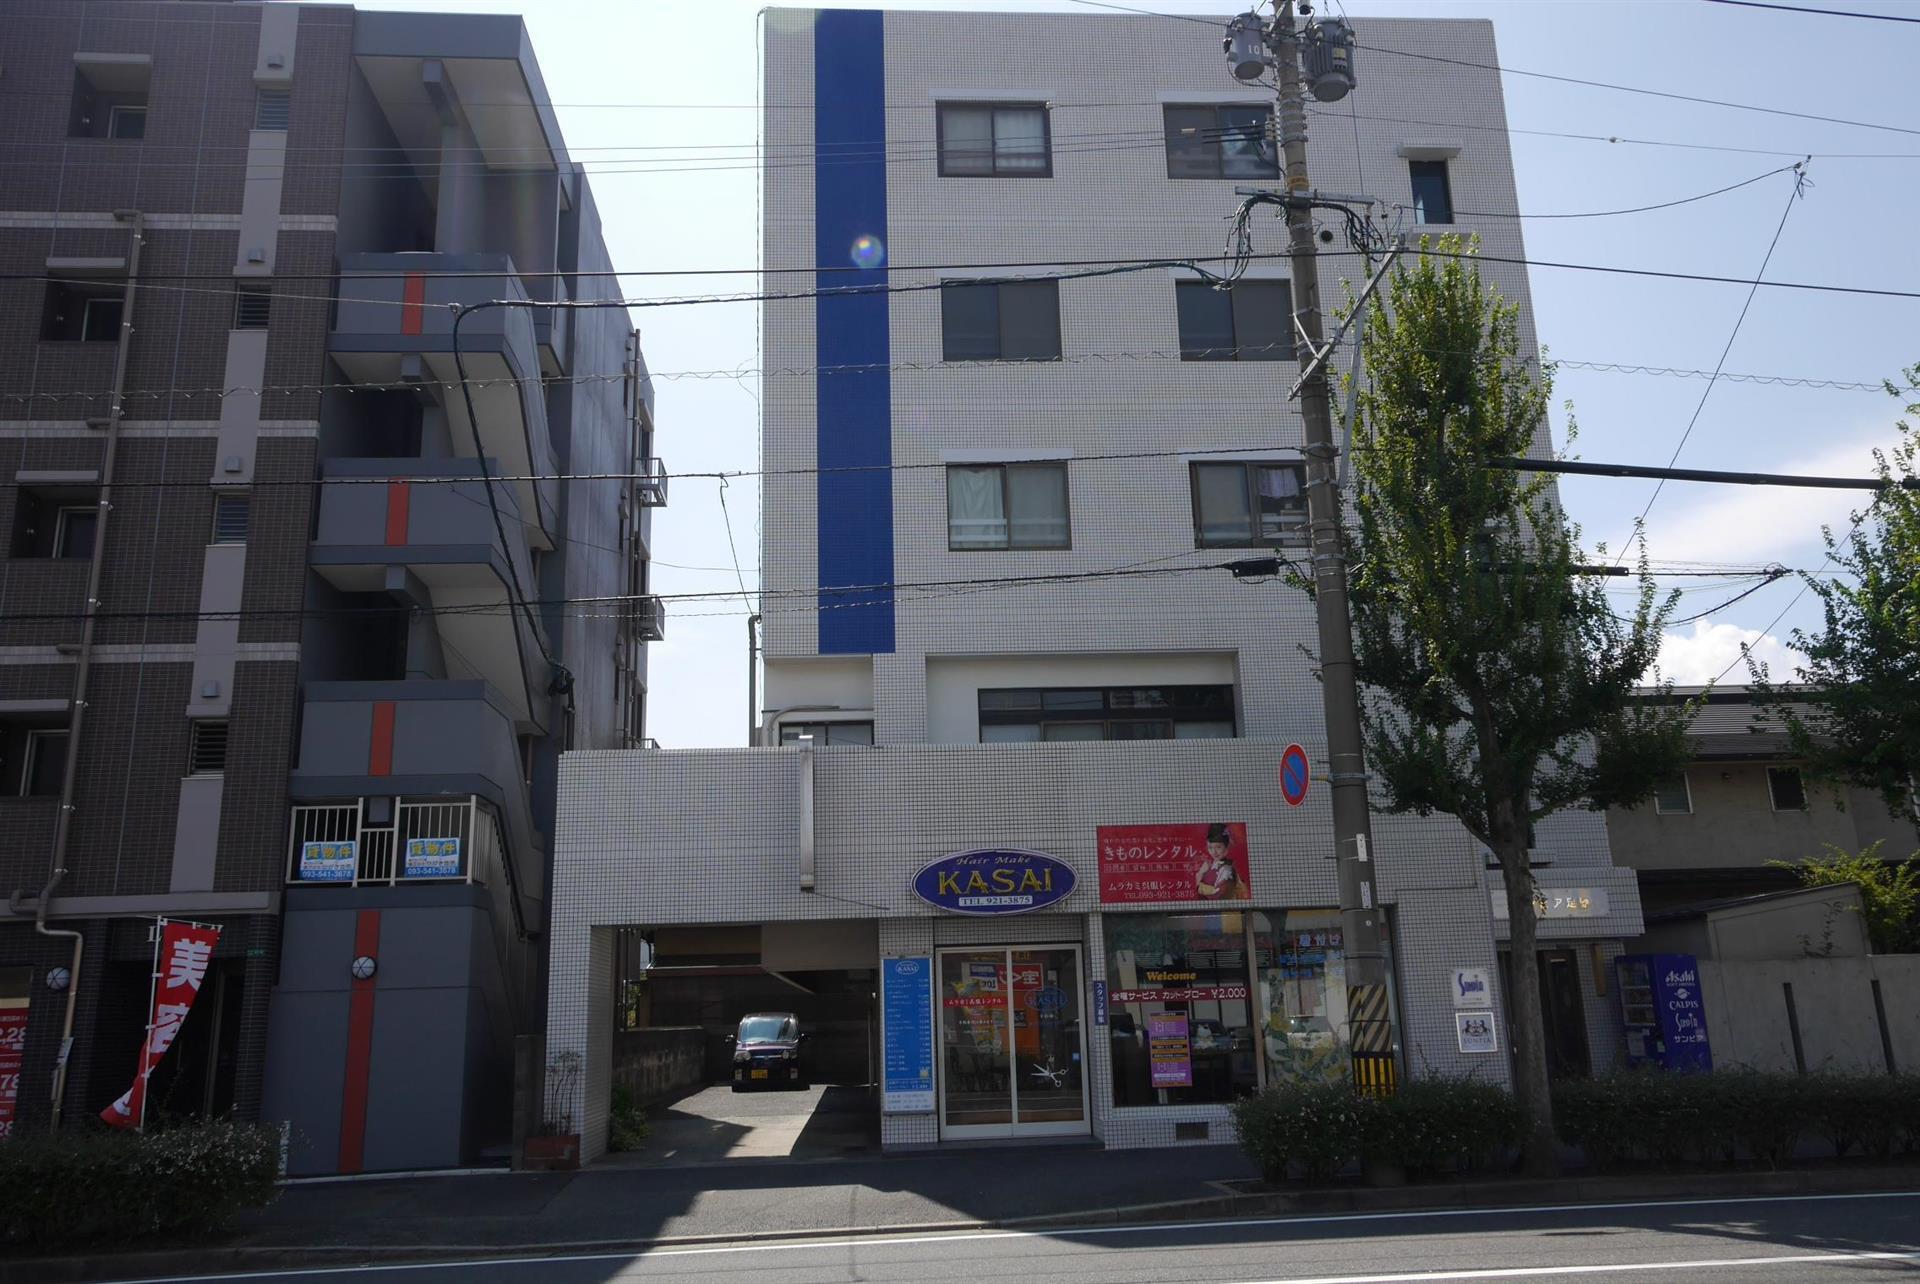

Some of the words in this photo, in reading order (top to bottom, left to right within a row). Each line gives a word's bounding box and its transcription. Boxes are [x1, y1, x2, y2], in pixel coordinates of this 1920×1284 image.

[1248, 44, 1260, 55] 10
[1104, 845, 1197, 861] きものレンタル
[957, 856, 990, 865] Hair
[995, 855, 1031, 864] Make
[937, 868, 1053, 895] KASAI
[986, 896, 1030, 904] 921-3875
[1146, 971, 1197, 981] Welcome
[1665, 970, 1695, 982] Asahi
[1669, 1000, 1699, 1010] CALPIS
[1674, 1034, 1704, 1043] サンピア
